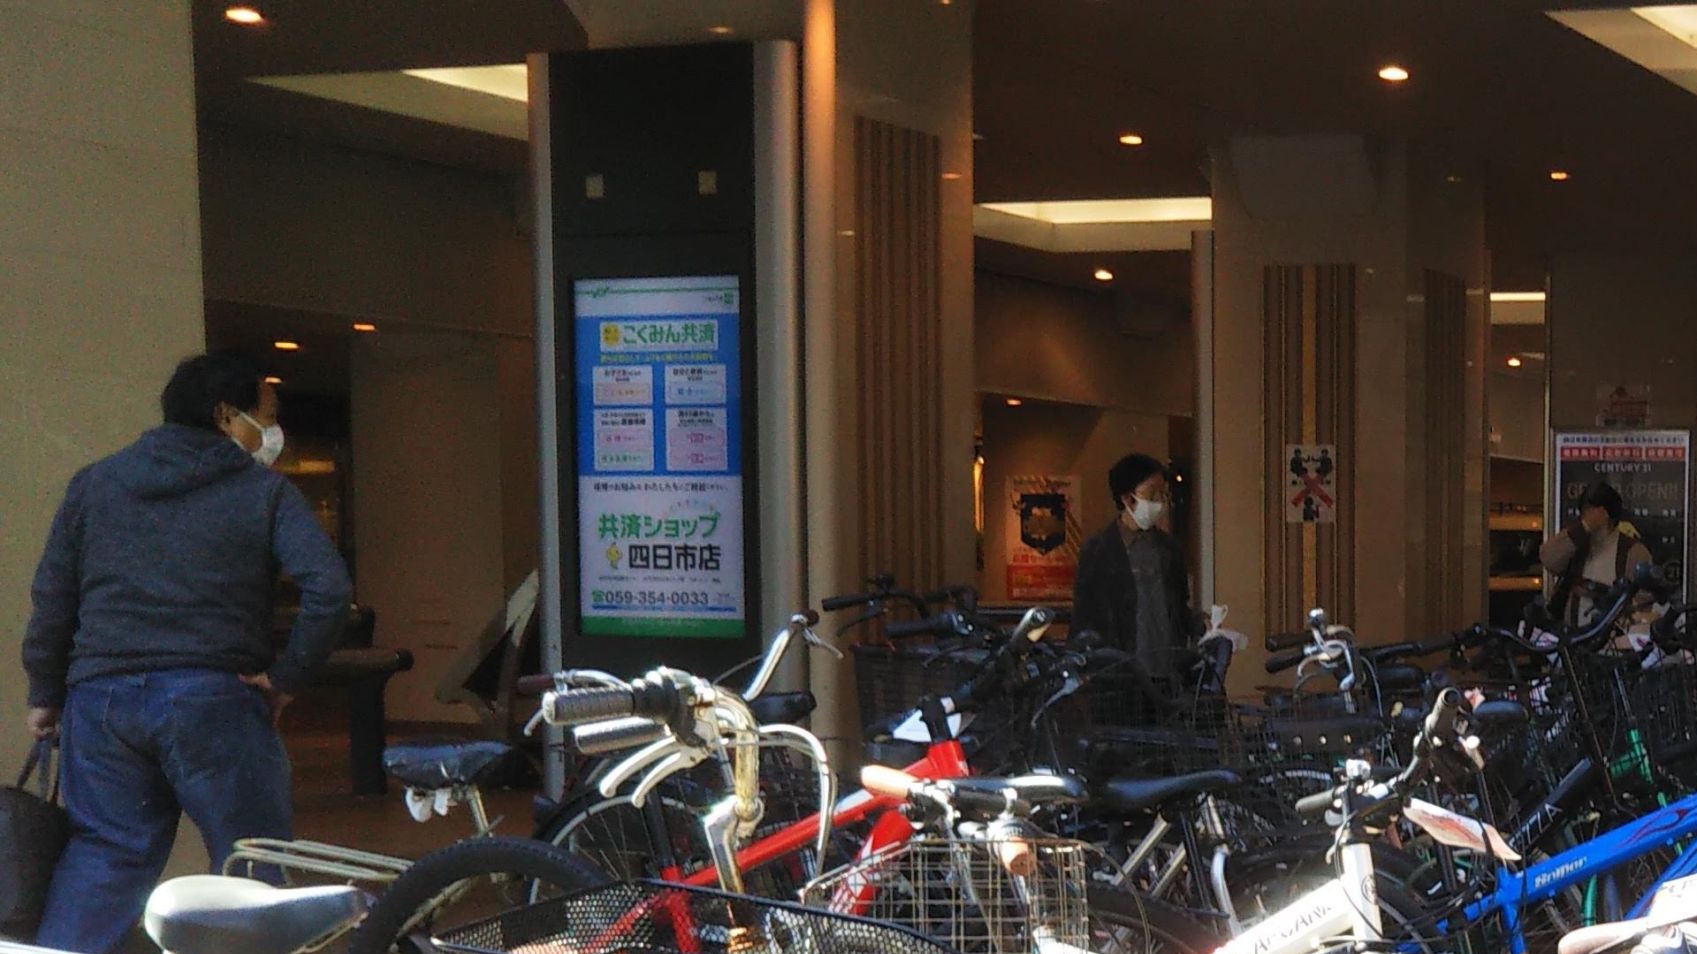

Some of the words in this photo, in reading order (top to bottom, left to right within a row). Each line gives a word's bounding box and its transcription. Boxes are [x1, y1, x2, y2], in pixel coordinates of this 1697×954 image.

[623, 322, 714, 344] こくみん共済
[1594, 462, 1639, 473] CENTURY
[598, 511, 721, 539] 共済ショップ
[628, 543, 722, 571] 四日市店
[604, 590, 709, 605] 059-354-0033
